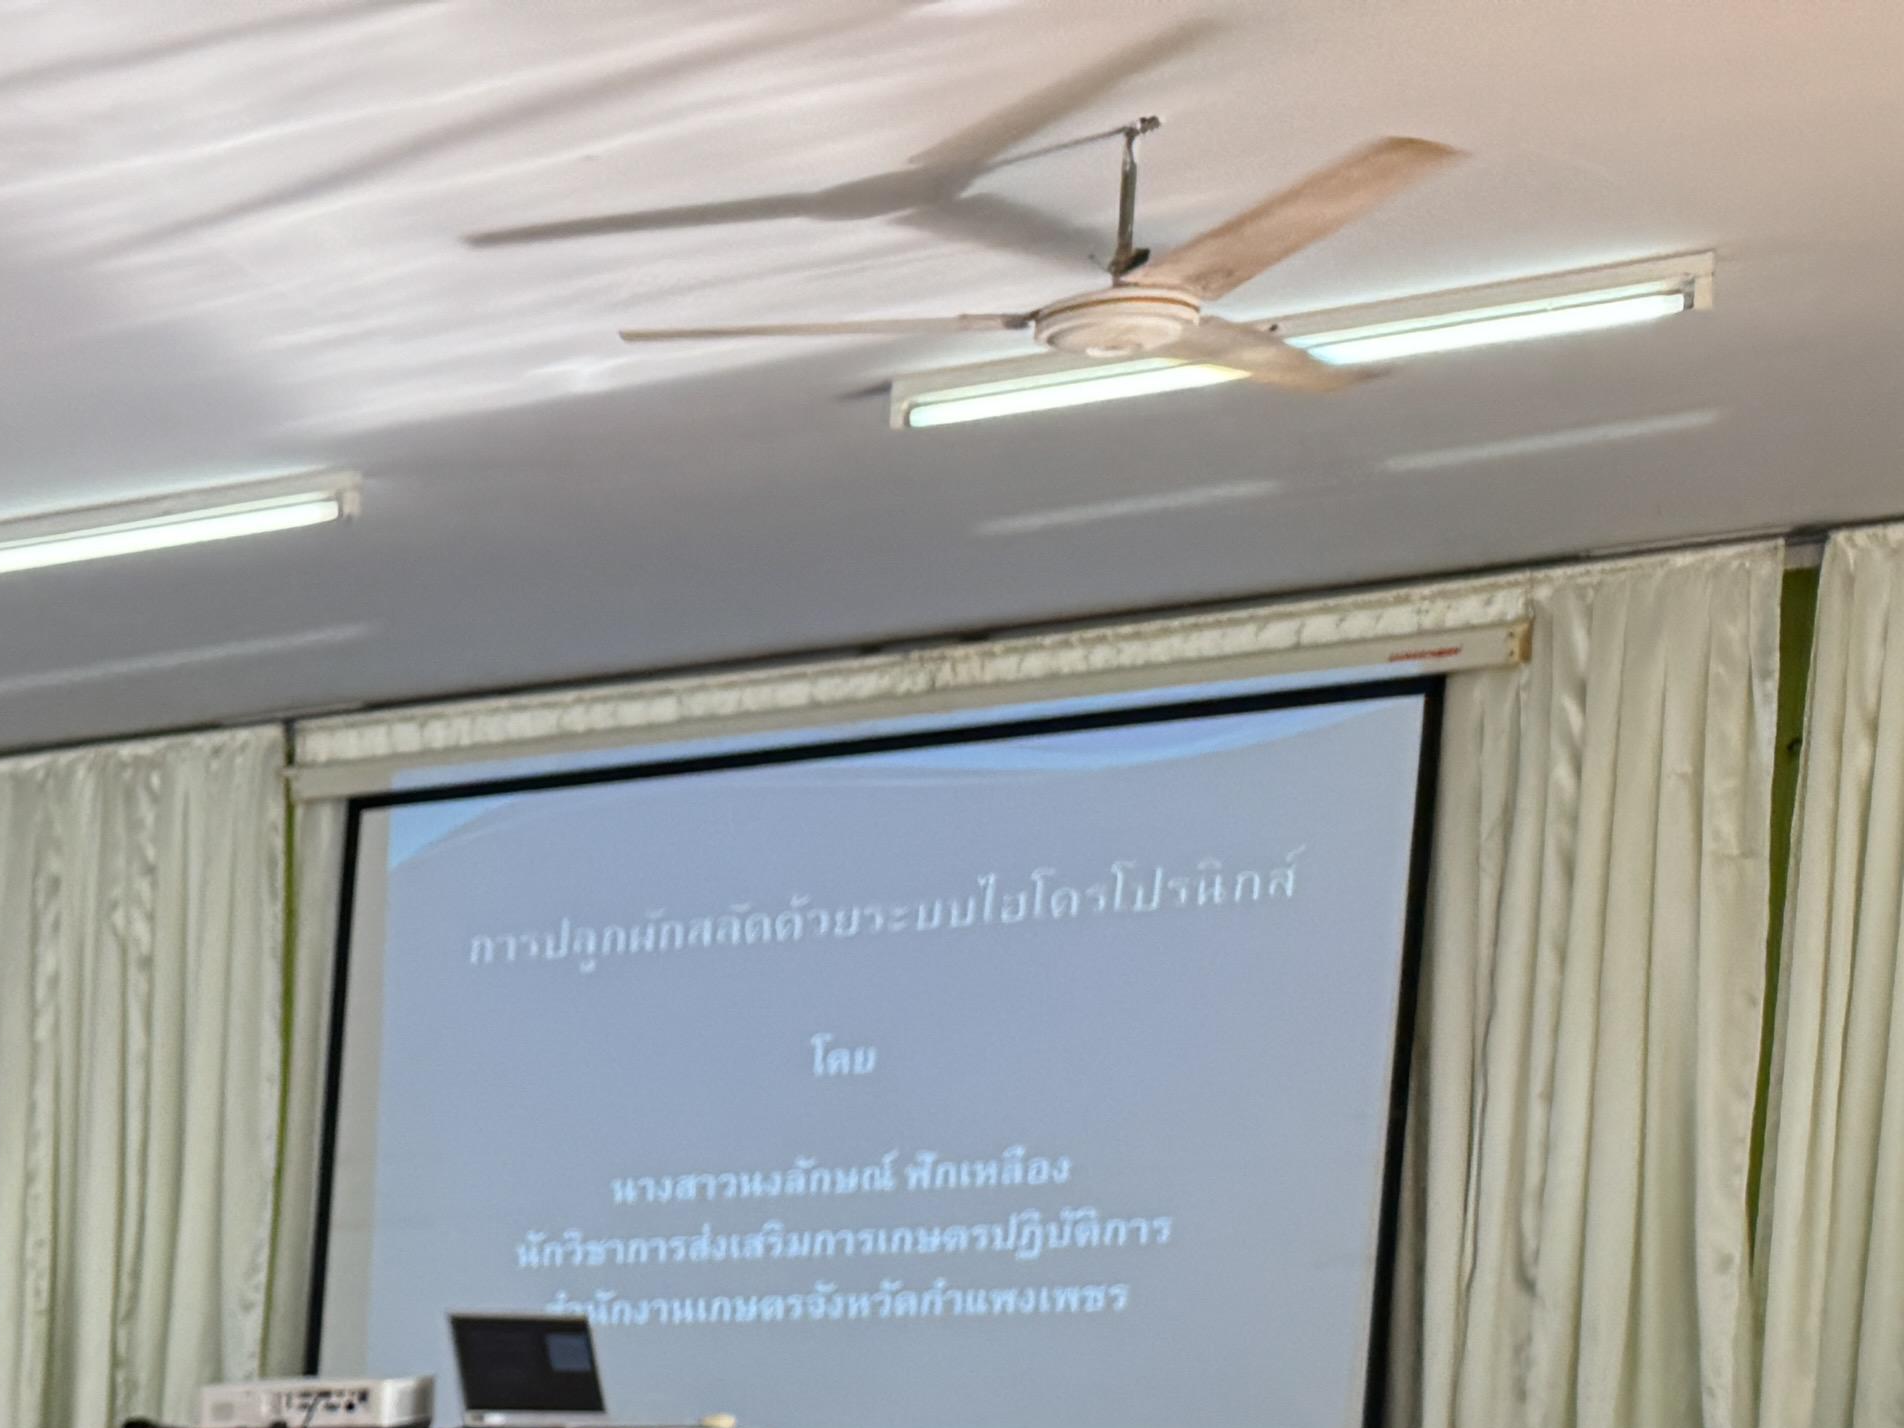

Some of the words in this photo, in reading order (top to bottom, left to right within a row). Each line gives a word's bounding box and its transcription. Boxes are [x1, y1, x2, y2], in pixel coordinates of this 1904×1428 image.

[810, 1032, 877, 1076] โดย
[610, 1150, 898, 1204] นางสาวนงลักษณ์
[516, 1207, 1173, 1268] นักวิชาการส่งเสริมการเกษตรปฏิบัติการ
